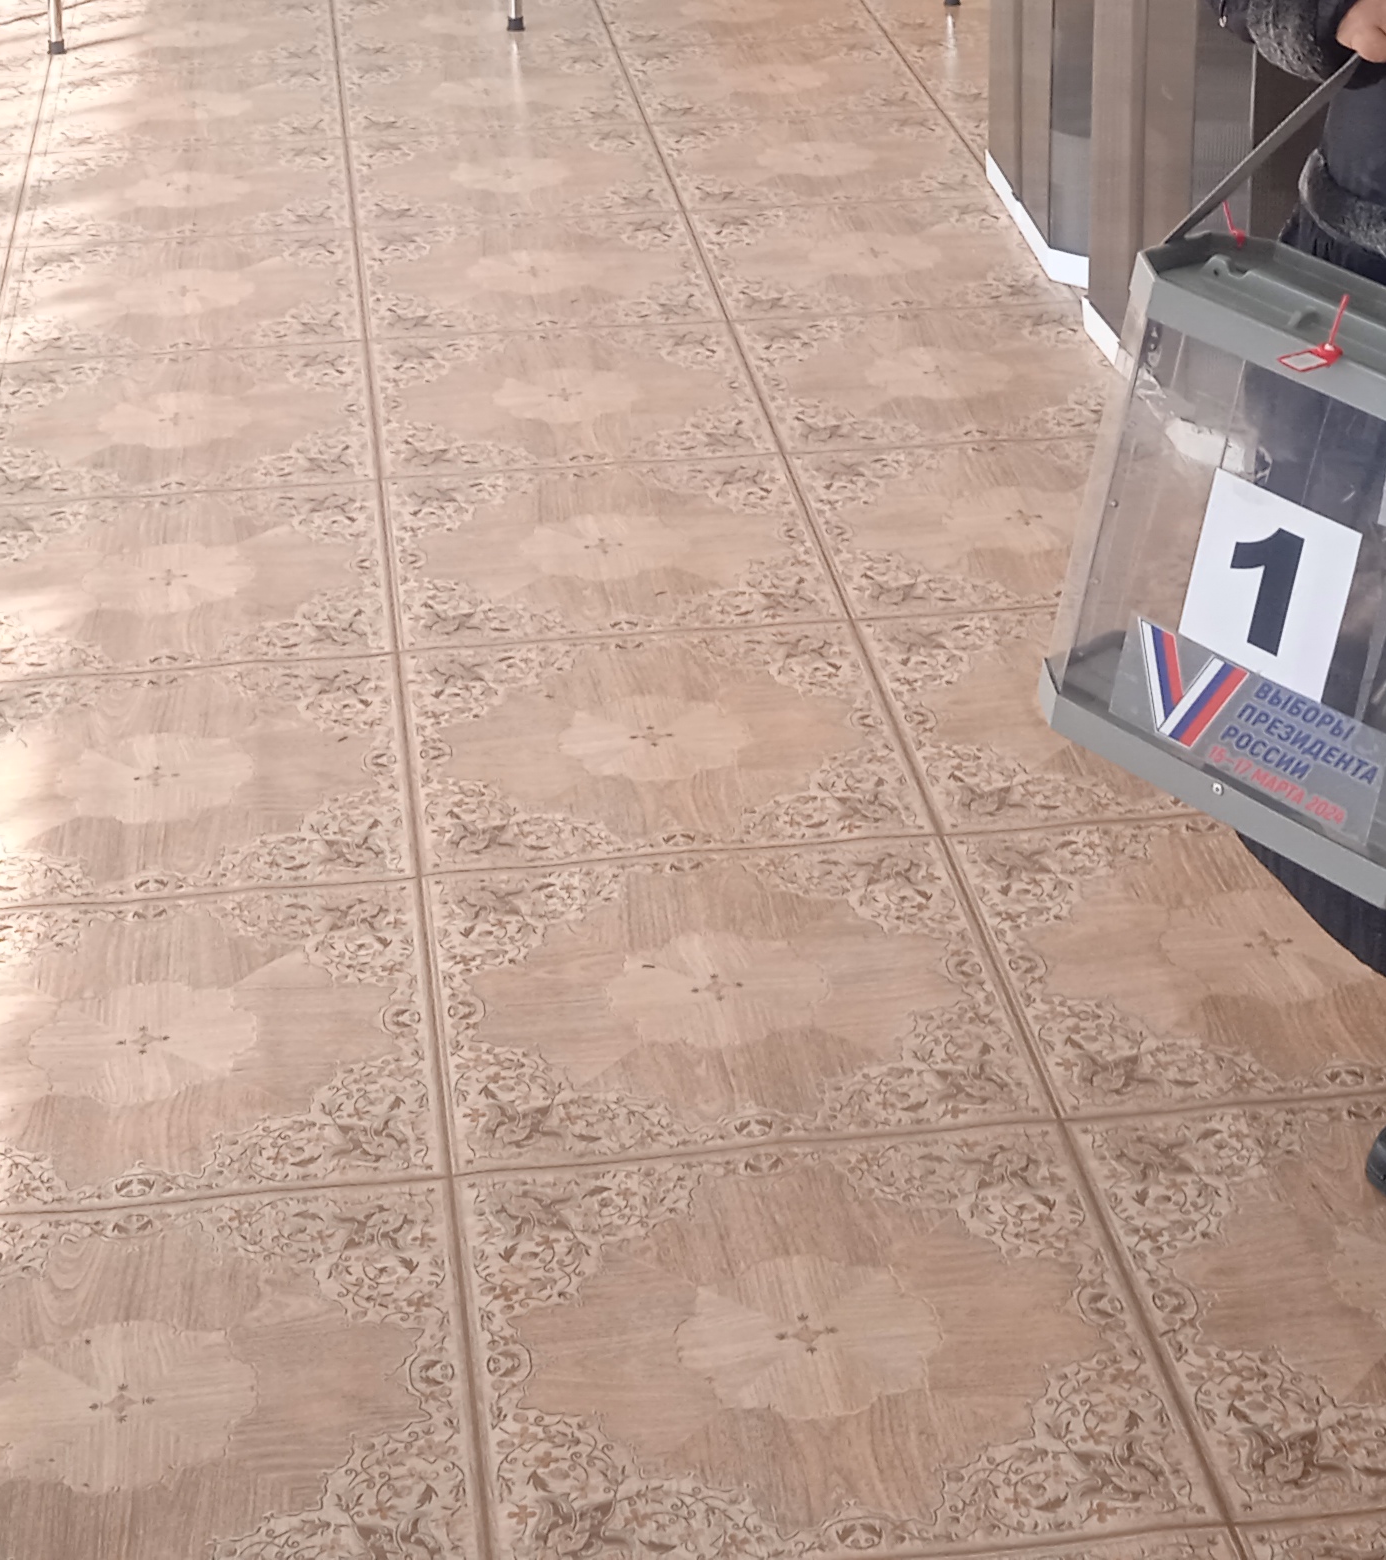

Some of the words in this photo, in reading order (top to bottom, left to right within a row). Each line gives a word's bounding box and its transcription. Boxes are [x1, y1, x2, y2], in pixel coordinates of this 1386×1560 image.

[1229, 527, 1305, 658] 1
[1253, 681, 1356, 742] ВЫБОРЫ
[1220, 724, 1312, 781] РОССИИ
[1236, 702, 1380, 786] ПРЕЗИДЕНТА
[1250, 767, 1307, 805] МАРТА
[1304, 792, 1347, 825] 2024
